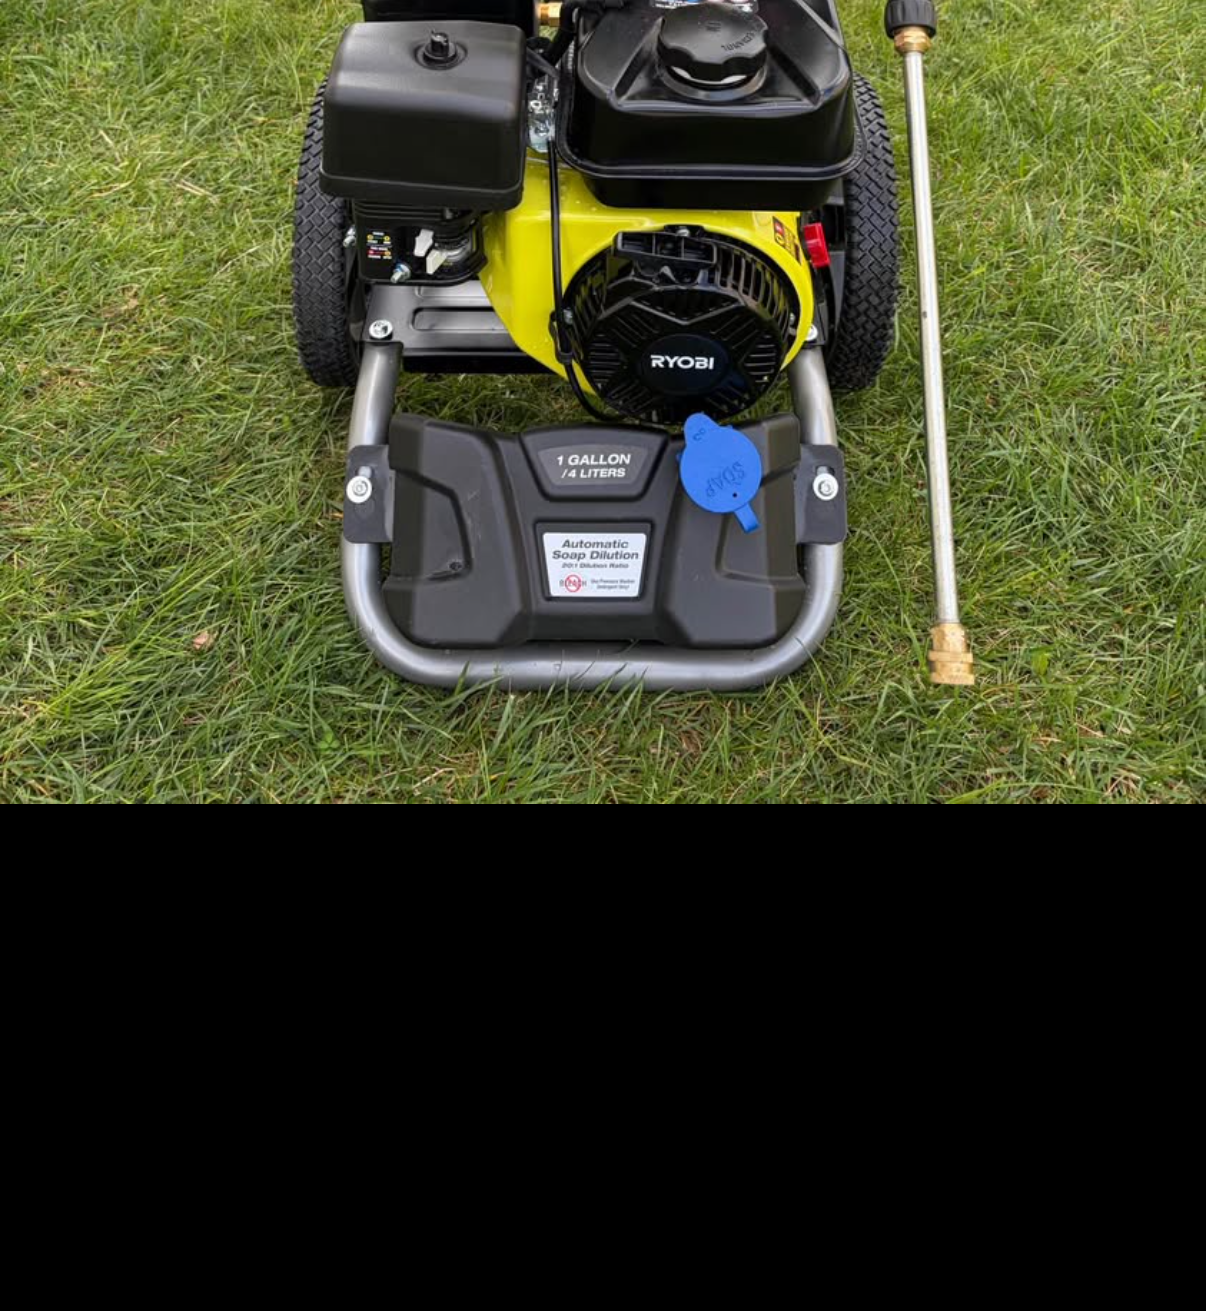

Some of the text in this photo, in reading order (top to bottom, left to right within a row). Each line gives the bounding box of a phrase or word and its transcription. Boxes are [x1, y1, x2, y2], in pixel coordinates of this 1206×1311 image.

[650, 355, 714, 370] RYOBI
[557, 453, 632, 466] 1 GALLON
[579, 467, 626, 479] LITERS
[561, 539, 629, 549] Automatic
[552, 550, 639, 562] Soap Dilution
